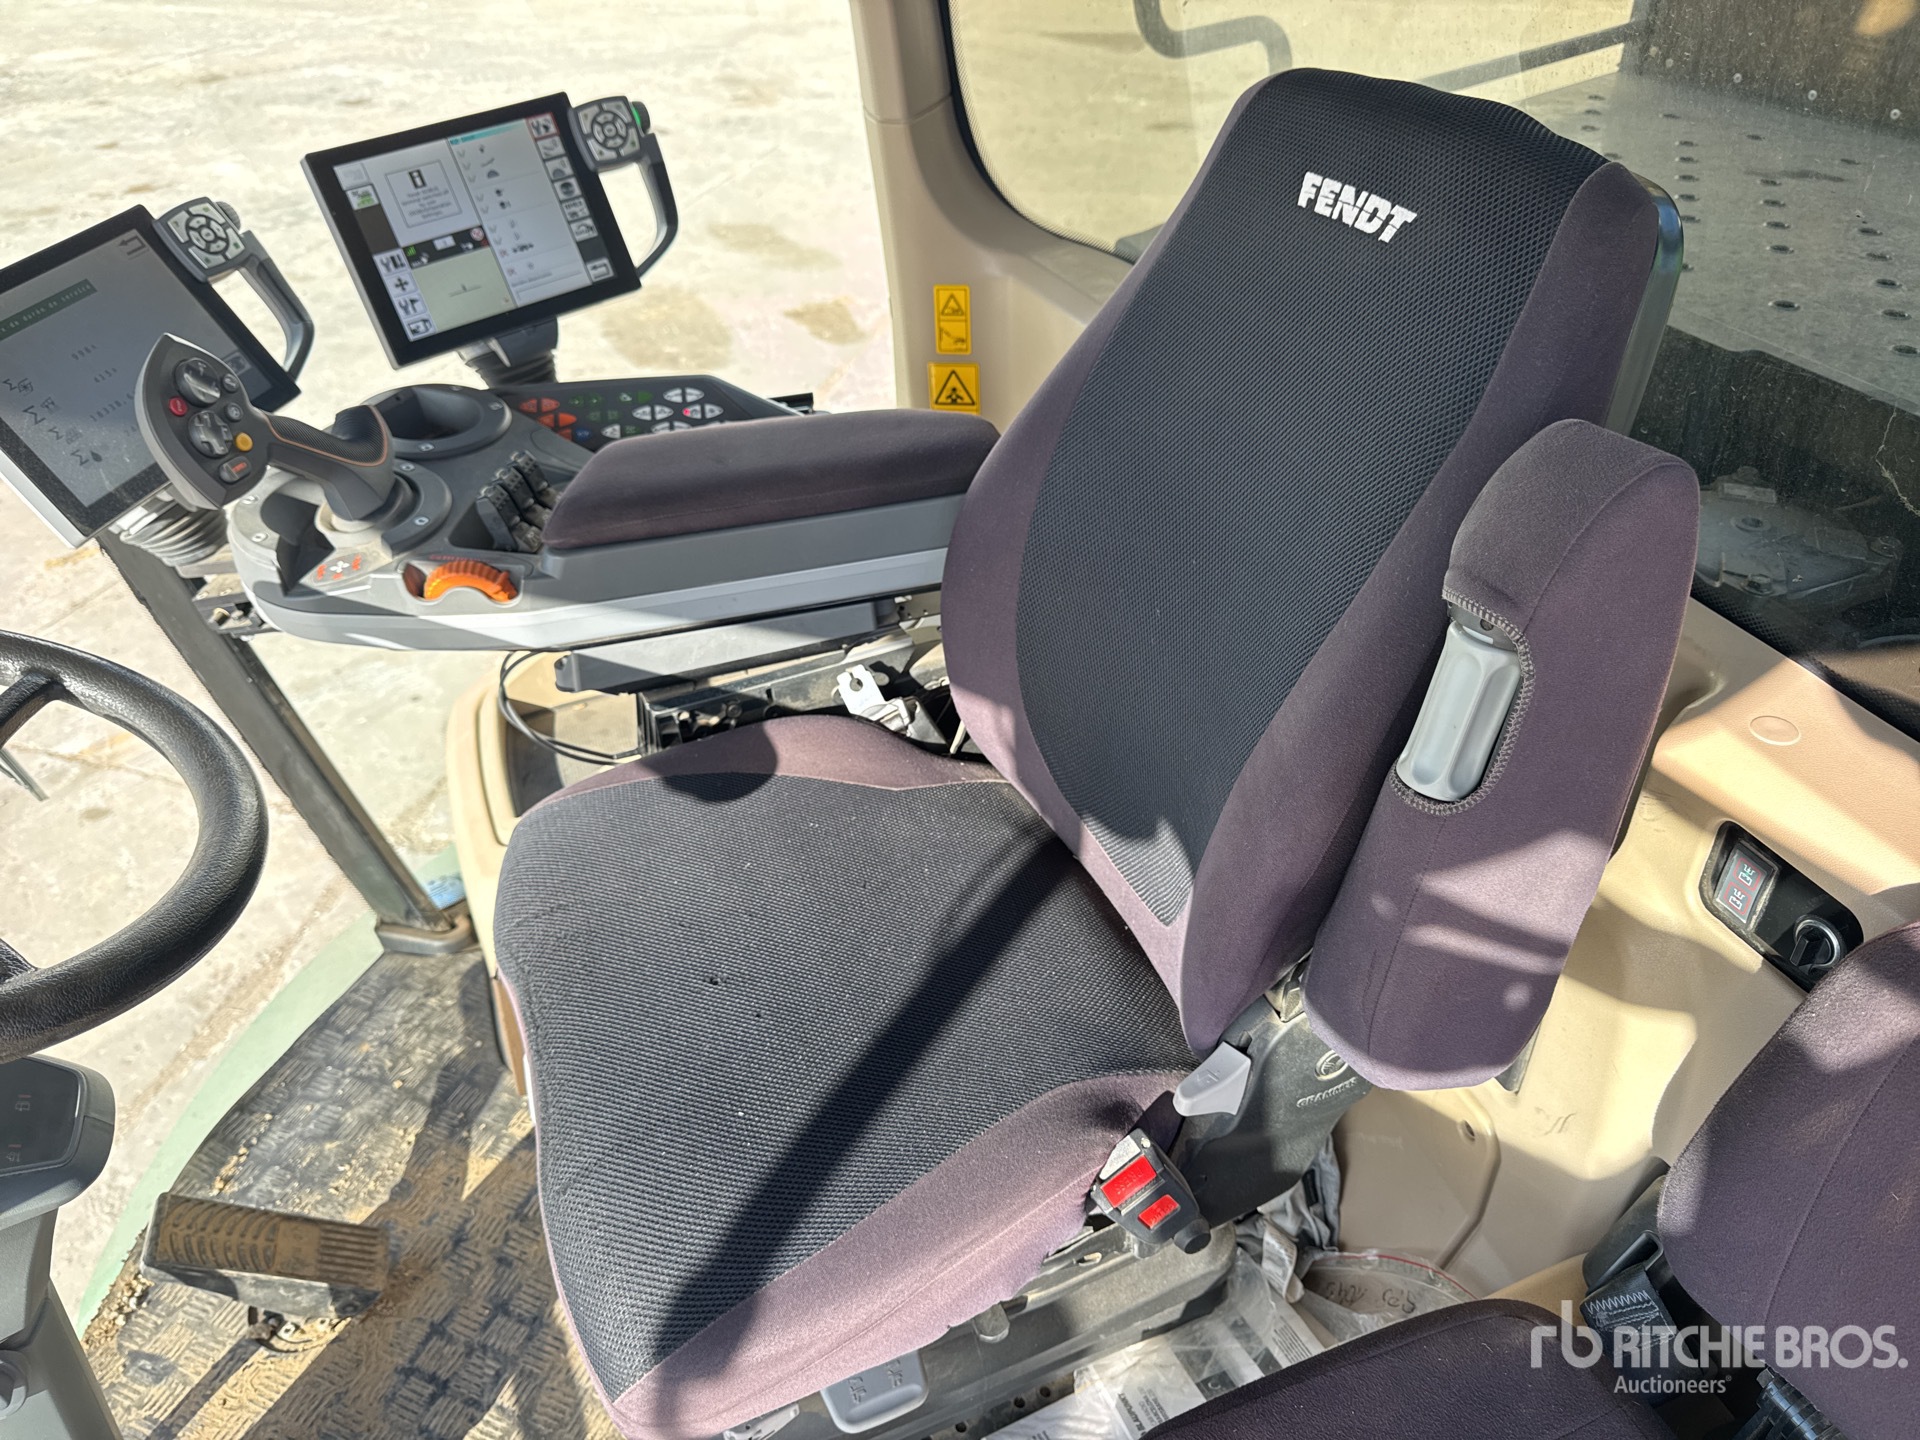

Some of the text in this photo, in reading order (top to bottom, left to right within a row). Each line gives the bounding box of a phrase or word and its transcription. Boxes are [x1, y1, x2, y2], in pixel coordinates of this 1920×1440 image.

[1297, 171, 1418, 243] FENDT
[1112, 1167, 1145, 1195] PRESS
[1118, 1392, 1146, 1432] BLAUPUNKT
